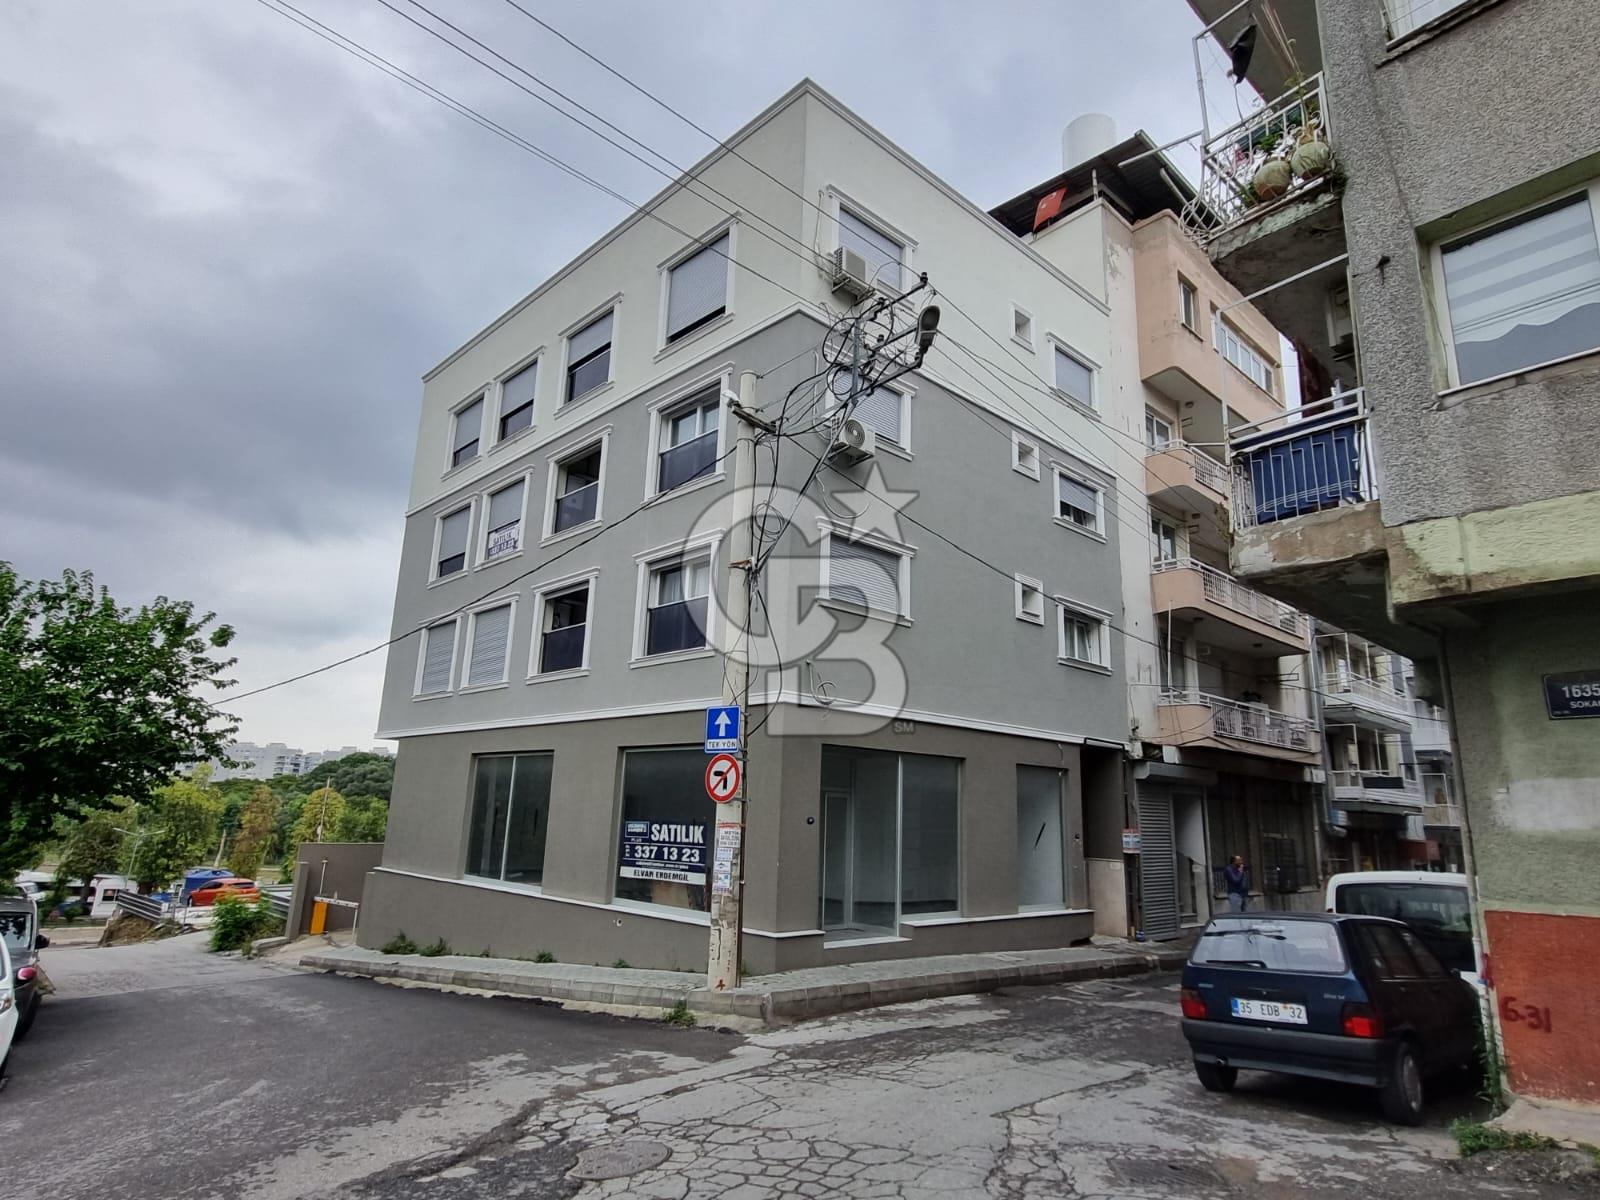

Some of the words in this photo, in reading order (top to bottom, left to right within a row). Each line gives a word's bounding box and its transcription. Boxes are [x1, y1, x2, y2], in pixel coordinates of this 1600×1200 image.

[1561, 683, 1600, 698] 1635
[1570, 700, 1600, 709] SOKA
[650, 823, 704, 844] SATILIK
[634, 845, 658, 859] 337
[662, 846, 678, 860] 13
[681, 848, 700, 863] 23
[633, 869, 654, 878] ELVAN
[1240, 1001, 1253, 1014] 35
[1289, 1006, 1303, 1019] 32
